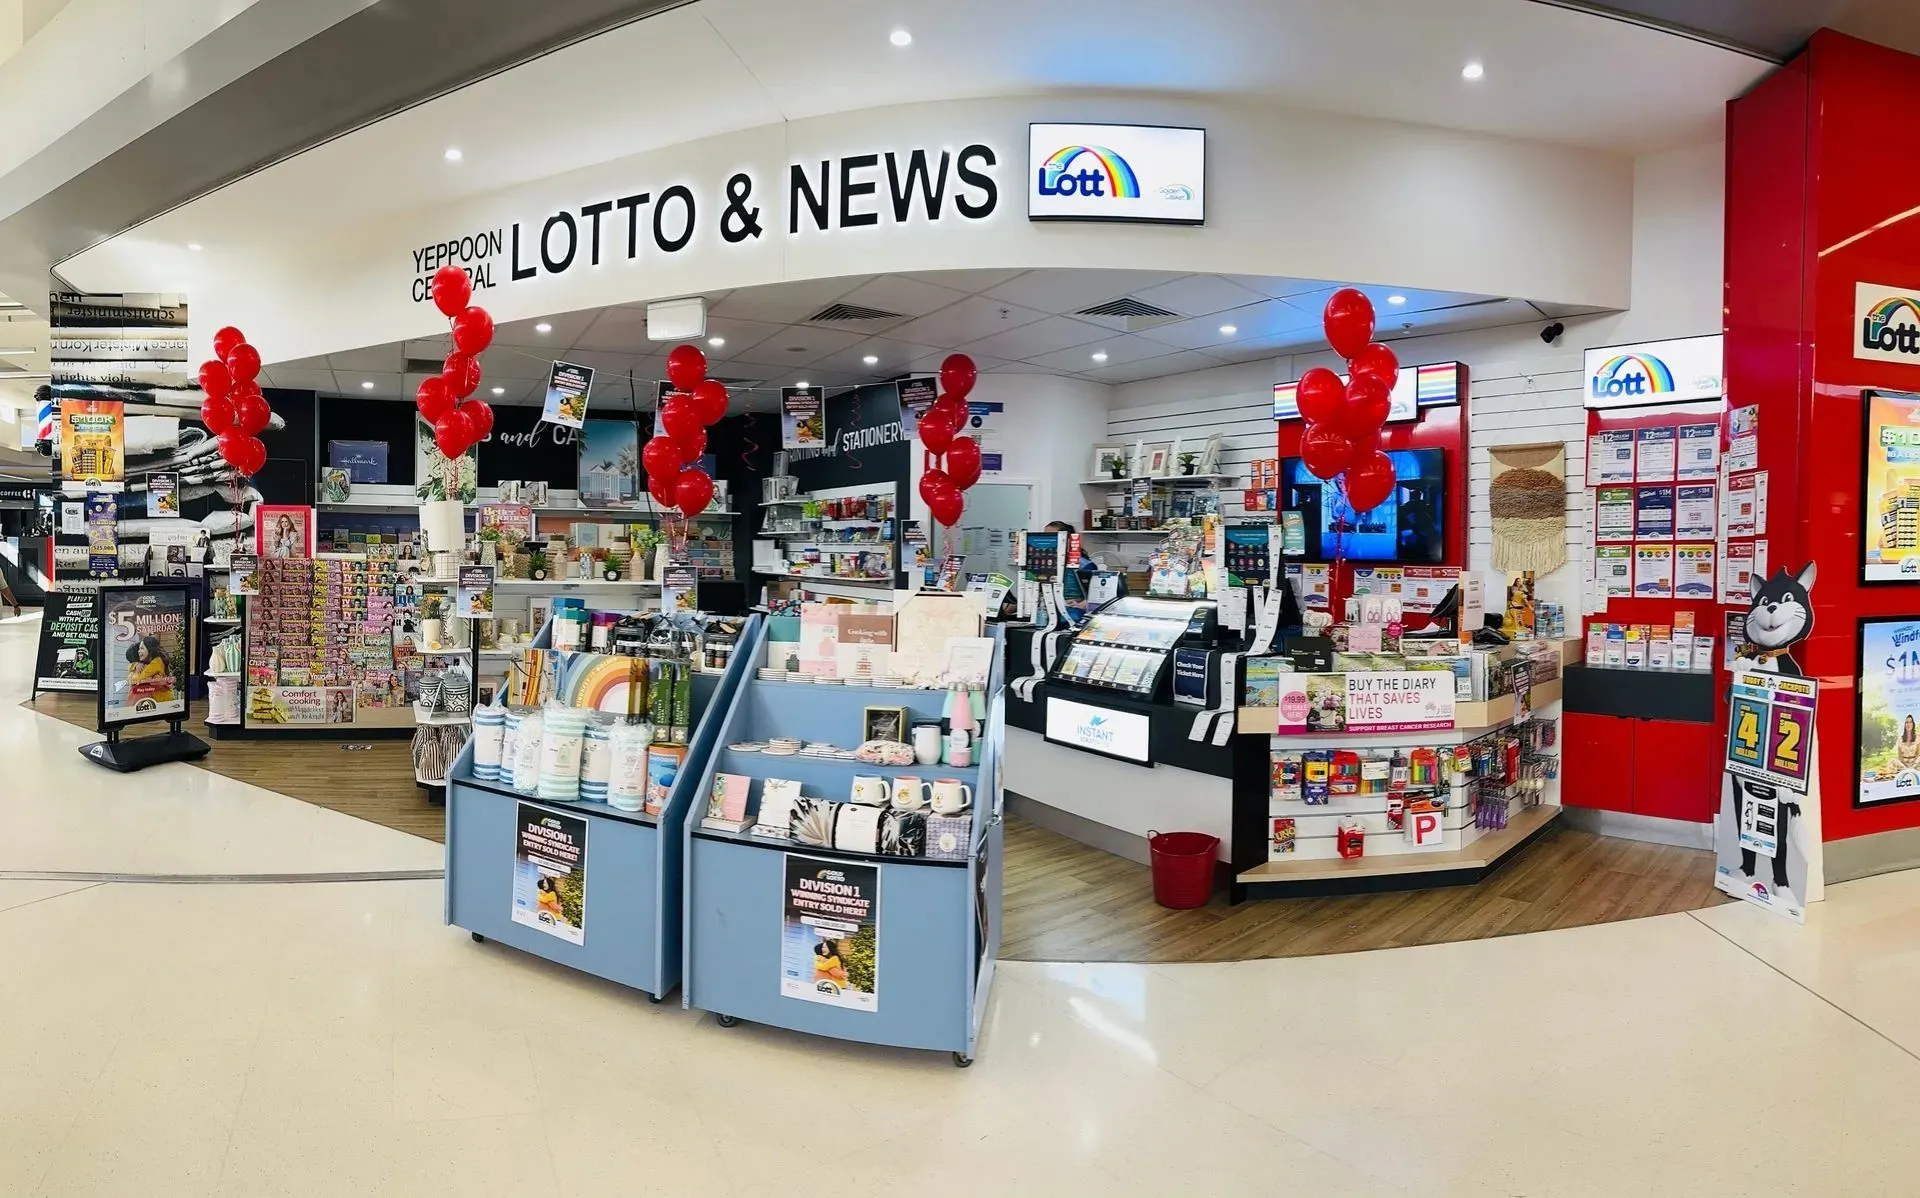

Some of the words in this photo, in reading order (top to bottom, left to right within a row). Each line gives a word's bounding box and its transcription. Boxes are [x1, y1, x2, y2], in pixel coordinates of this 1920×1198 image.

[1039, 167, 1104, 196] Lott
[510, 185, 696, 282] LOTTO
[719, 173, 762, 244] &
[789, 143, 999, 235] NEWS
[412, 229, 502, 274] YEPPOON
[1863, 317, 1919, 353] Lott
[1593, 371, 1646, 399] Lott
[340, 456, 378, 467] Hallmark
[50, 622, 83, 632] DEPOSIT
[108, 610, 135, 642] $5
[136, 612, 179, 625] MILLION
[136, 623, 180, 634] SATURDAYS
[1349, 678, 1373, 691] BUY
[1376, 678, 1399, 690] THE
[1402, 677, 1436, 690] DIARY
[281, 690, 317, 698] Comfort
[288, 698, 321, 706] cooking
[1349, 692, 1380, 705] THAT
[1383, 691, 1421, 705] SAVES
[1349, 706, 1383, 720] LIVES
[528, 823, 567, 842] DIVISION
[1274, 827, 1296, 841] UNO
[1415, 815, 1437, 844] P
[523, 839, 543, 851] ENTRY
[543, 845, 559, 856] SOLD
[547, 839, 580, 855] SYNDICATE
[799, 878, 853, 897] DIVISION
[853, 886, 861, 898] 1
[790, 888, 827, 902] WINNING
[827, 895, 870, 908] SYNDICATE
[793, 898, 820, 910] ENTRY
[820, 903, 843, 913] SOLD
[843, 906, 868, 917] HERE!
